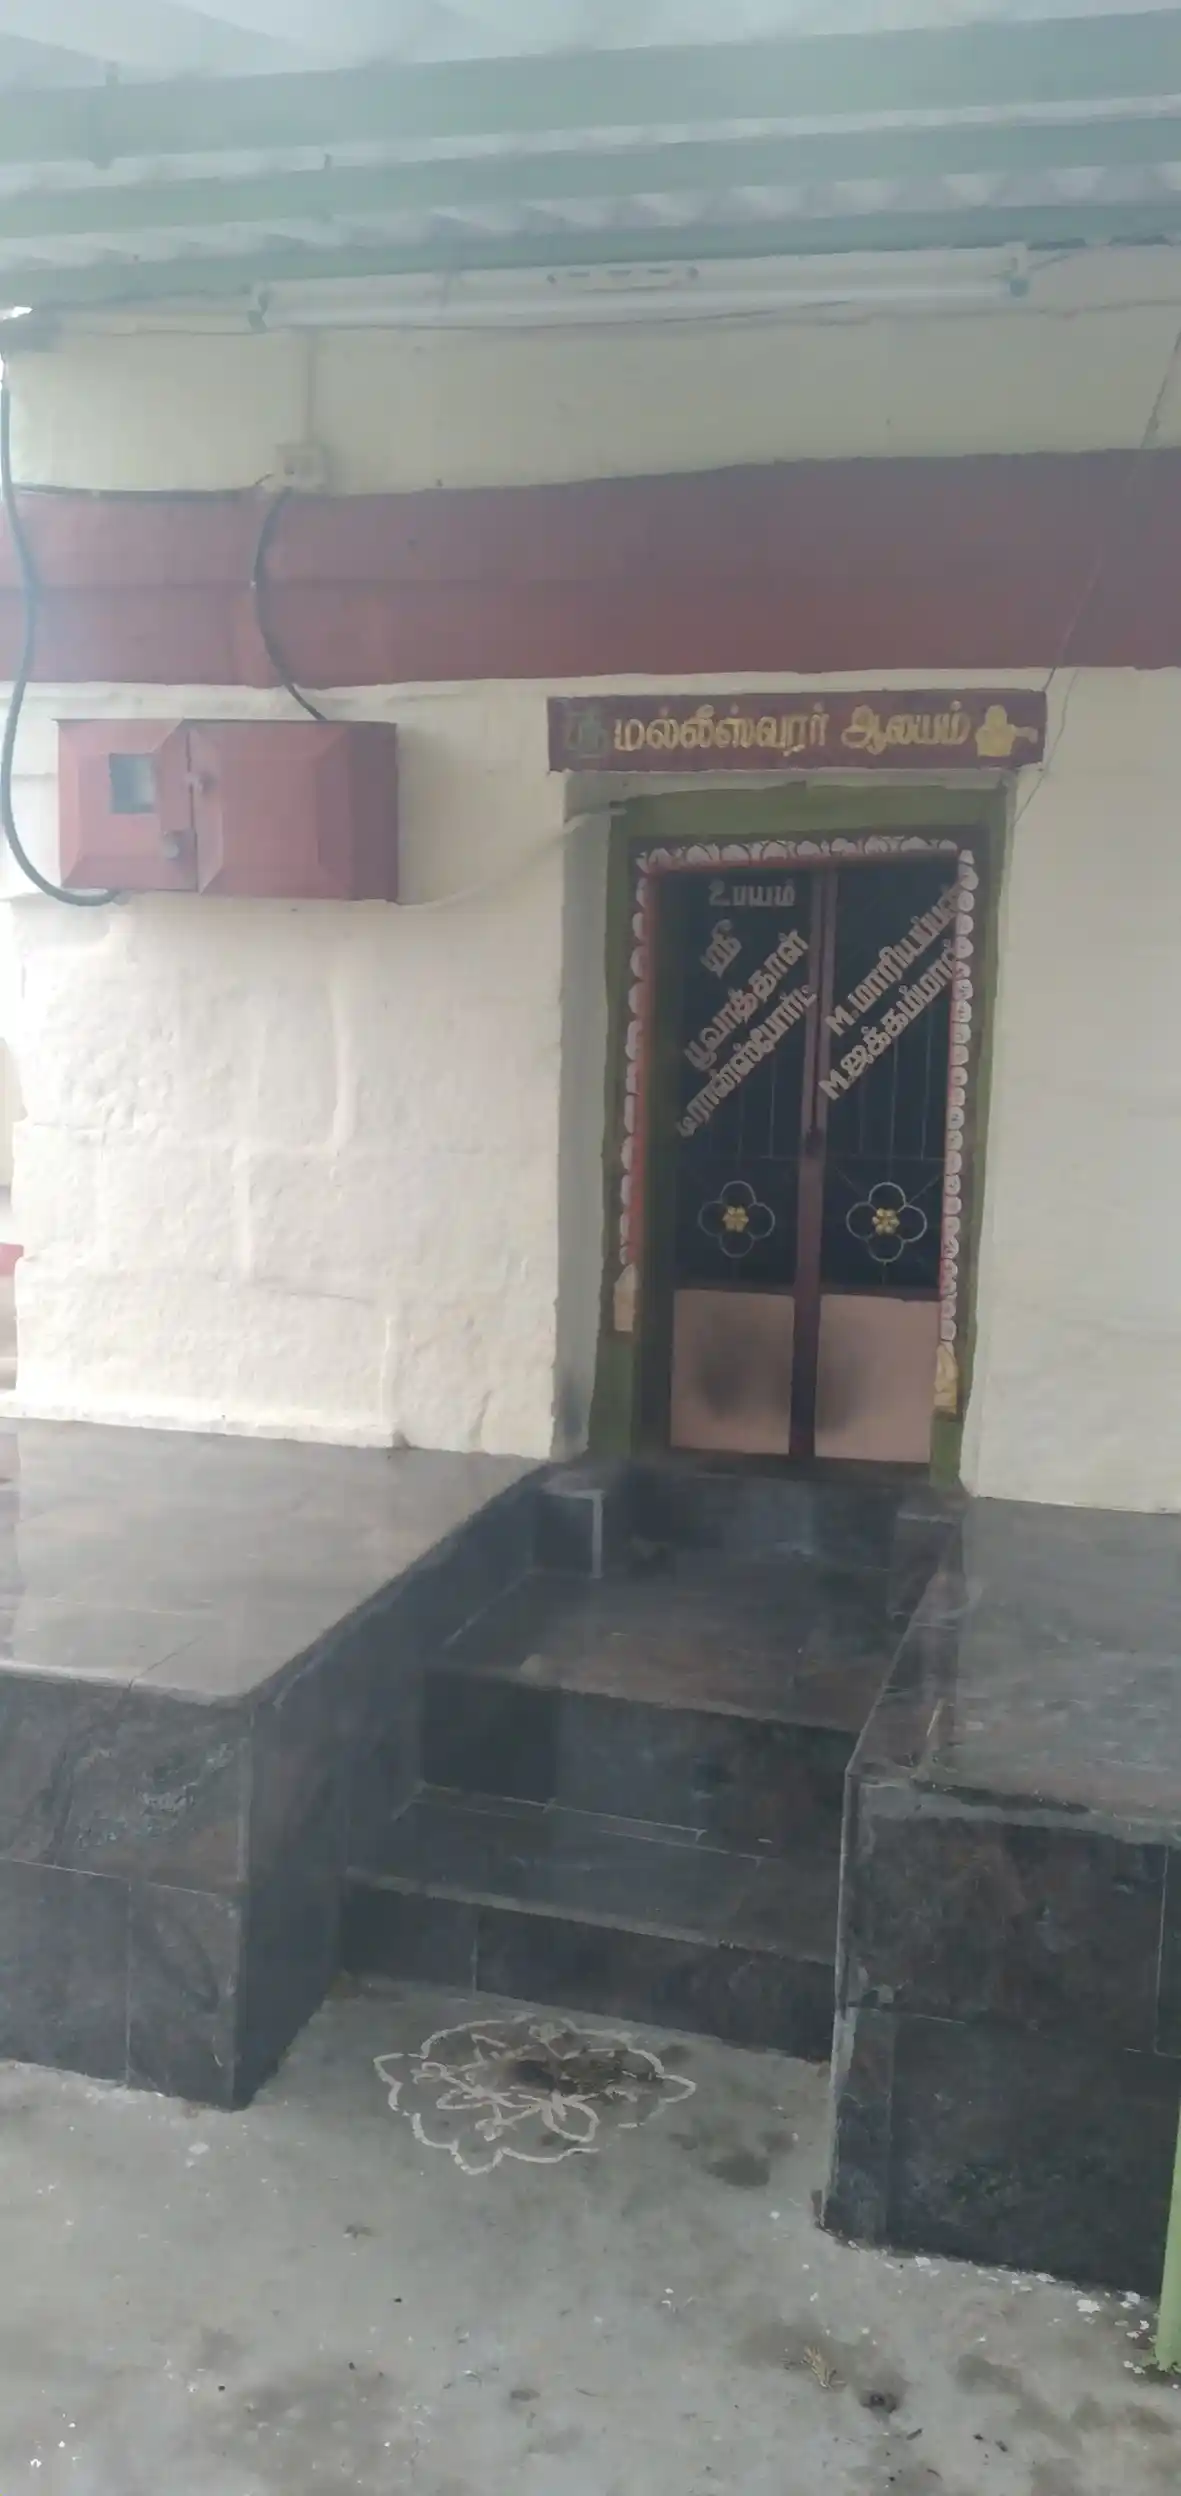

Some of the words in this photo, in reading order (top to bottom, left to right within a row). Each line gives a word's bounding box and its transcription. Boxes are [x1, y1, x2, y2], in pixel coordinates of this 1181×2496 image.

[614, 703, 829, 757] மல்லீஸ்வரர்
[842, 700, 971, 755] ஆலயம்
[708, 879, 796, 907] உபயம்
